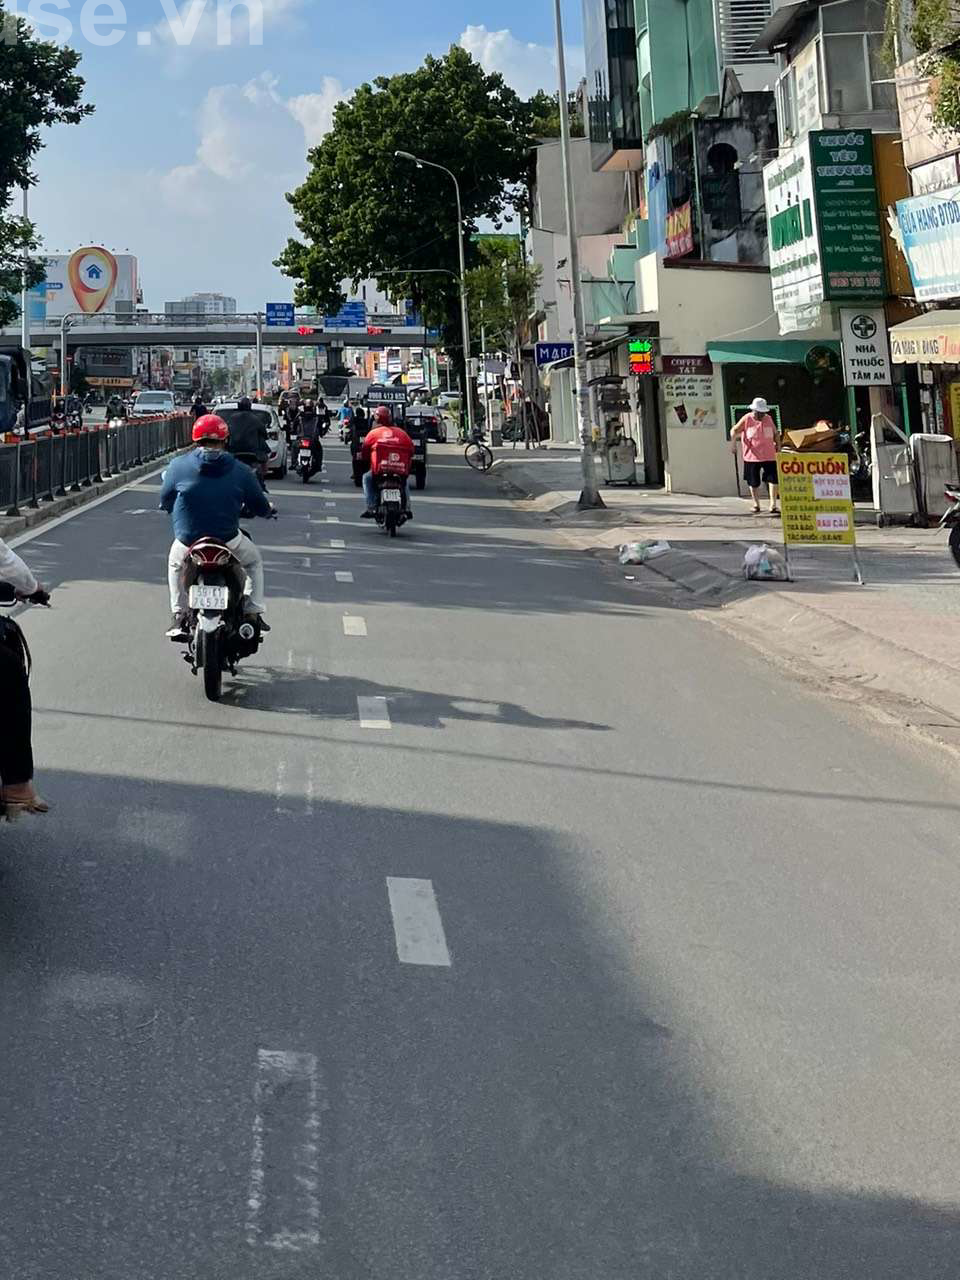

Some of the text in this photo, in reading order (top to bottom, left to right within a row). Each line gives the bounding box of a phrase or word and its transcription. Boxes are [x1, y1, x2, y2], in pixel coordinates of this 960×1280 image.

[855, 343, 876, 353] NHÀ
[671, 358, 702, 366] COFFEE
[849, 355, 885, 367] THUỐC
[852, 369, 885, 380] TÂM AN
[807, 457, 846, 475] CUỐN
